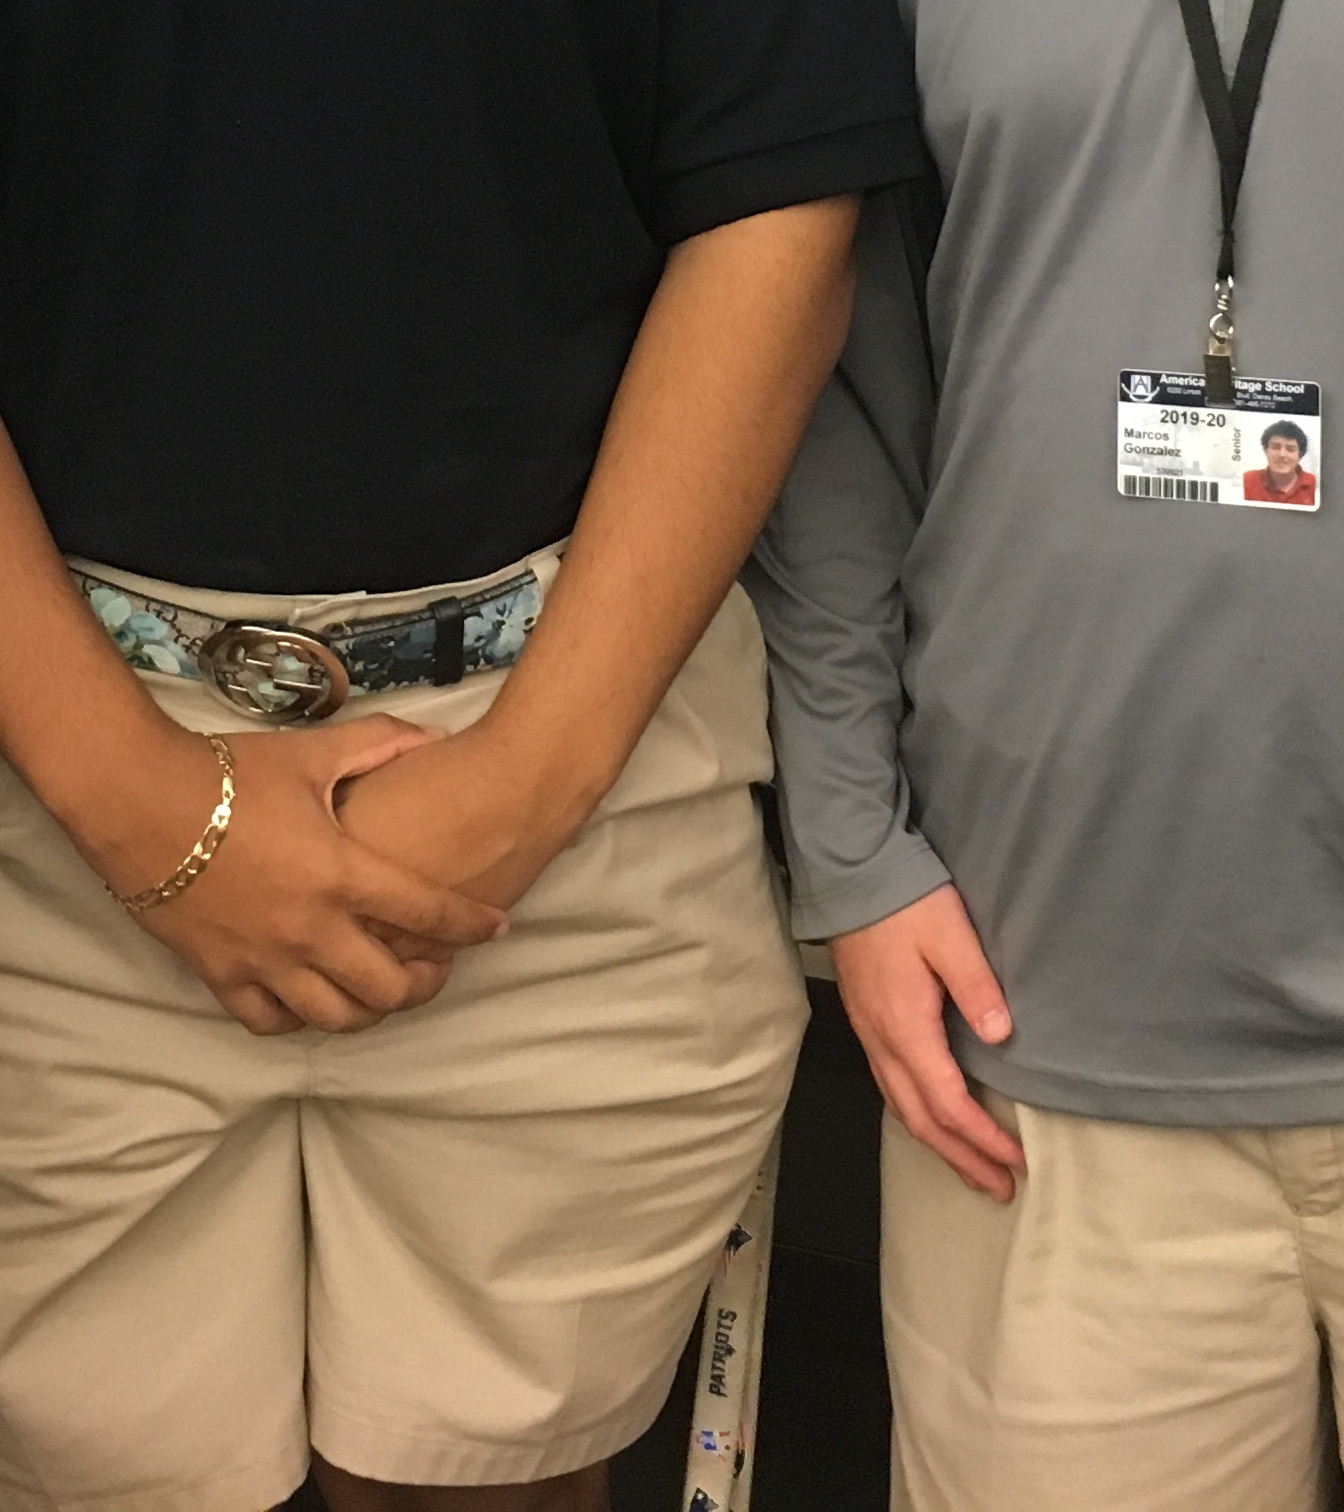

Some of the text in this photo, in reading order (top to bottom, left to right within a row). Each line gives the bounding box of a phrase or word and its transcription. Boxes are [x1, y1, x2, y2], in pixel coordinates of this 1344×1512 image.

[1159, 373, 1305, 394] America School
[1159, 409, 1227, 428] 2019-20
[1124, 427, 1170, 441] Marcos
[1124, 443, 1182, 457] Gonzalez
[1232, 427, 1242, 462] Senior
[708, 1308, 738, 1398] PATRIOTS
